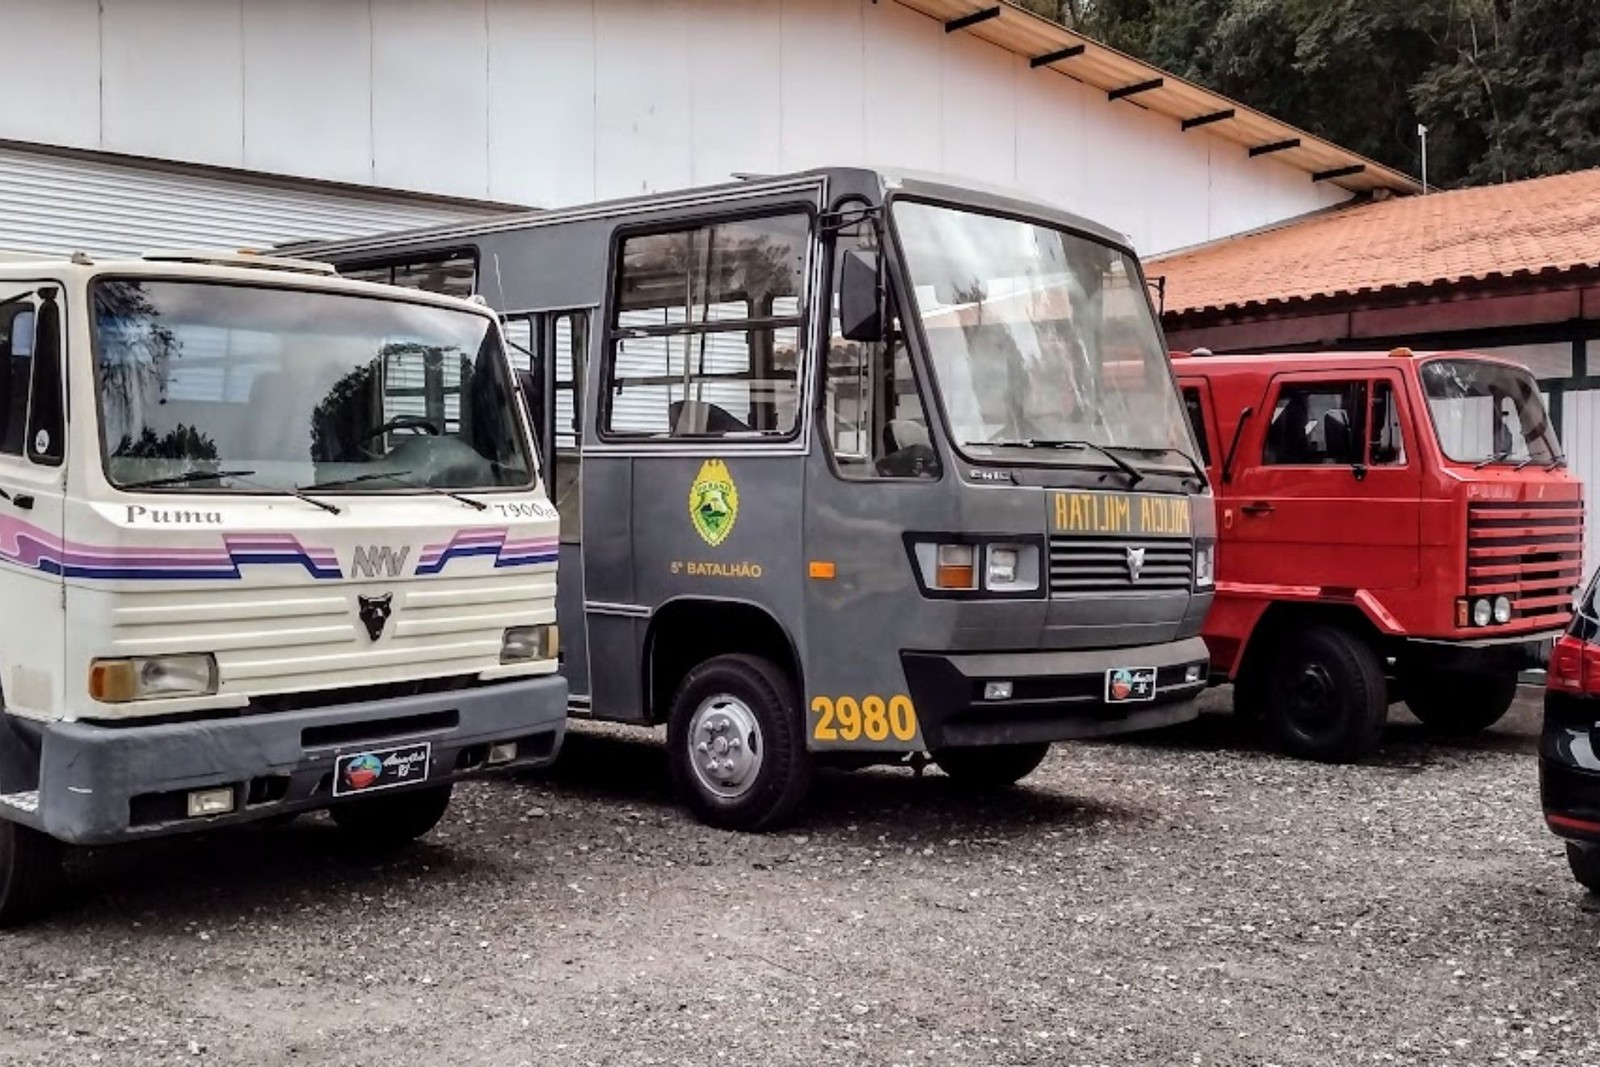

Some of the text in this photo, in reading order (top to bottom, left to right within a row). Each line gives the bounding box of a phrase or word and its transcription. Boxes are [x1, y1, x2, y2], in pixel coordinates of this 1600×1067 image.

[126, 504, 224, 524] Puma
[687, 561, 762, 578] BATALHÃO
[811, 694, 916, 741] 2980
